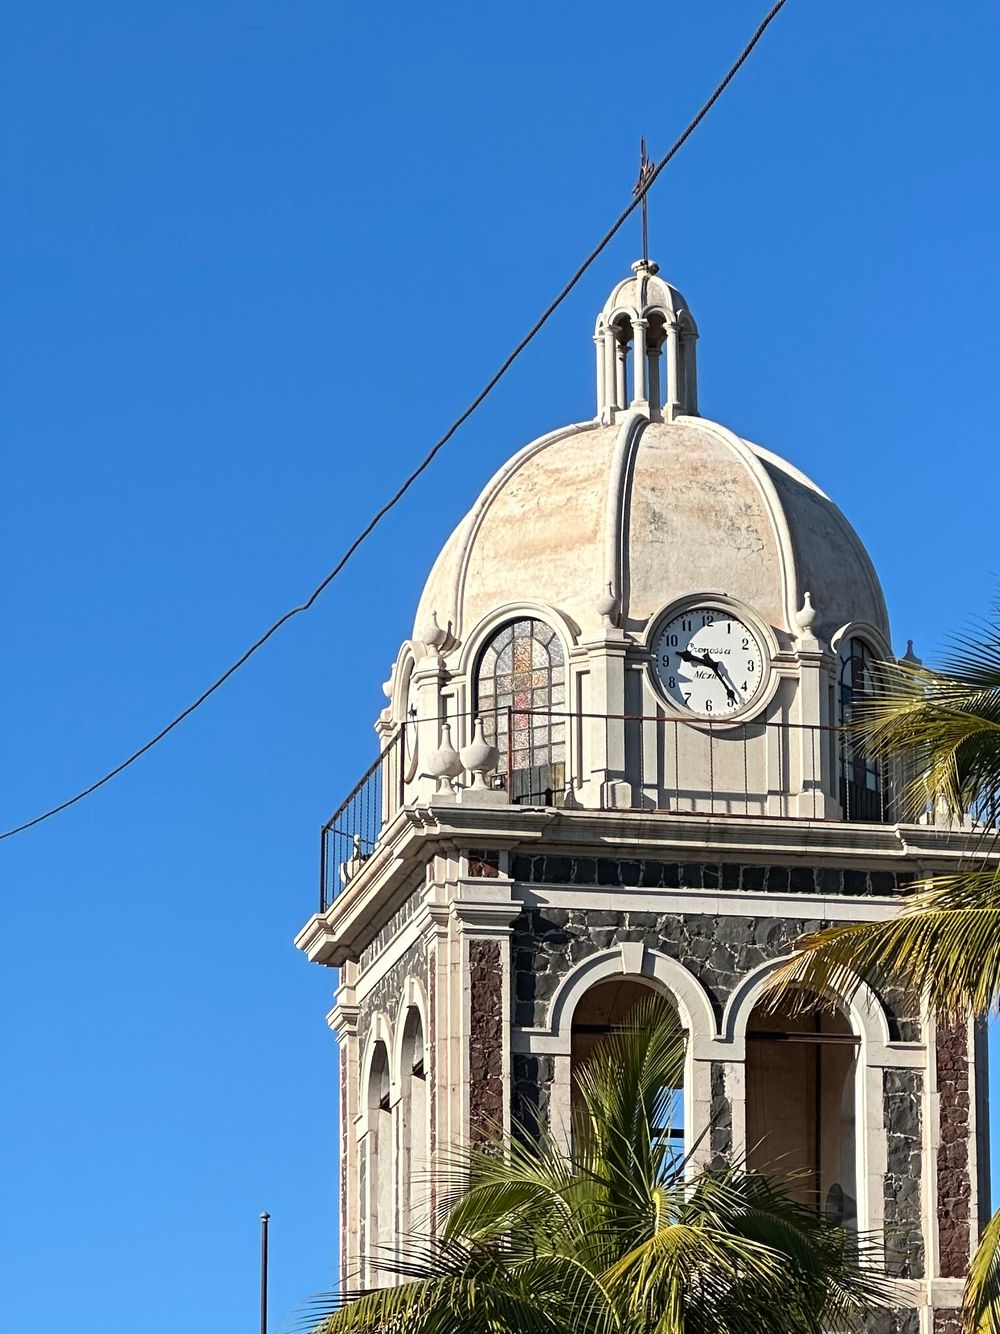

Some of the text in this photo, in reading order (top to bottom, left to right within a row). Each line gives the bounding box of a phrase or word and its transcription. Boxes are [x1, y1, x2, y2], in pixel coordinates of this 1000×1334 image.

[682, 620, 692, 631] 11
[702, 616, 714, 627] 12
[727, 623, 731, 634] 1
[666, 635, 678, 646] 10
[742, 639, 749, 650] 2
[663, 656, 669, 667] 9
[748, 660, 754, 672] 3
[669, 676, 675, 688] 8
[741, 681, 747, 691] 4
[685, 693, 692, 704] 7
[727, 698, 734, 707] 5
[706, 700, 712, 711] 6
